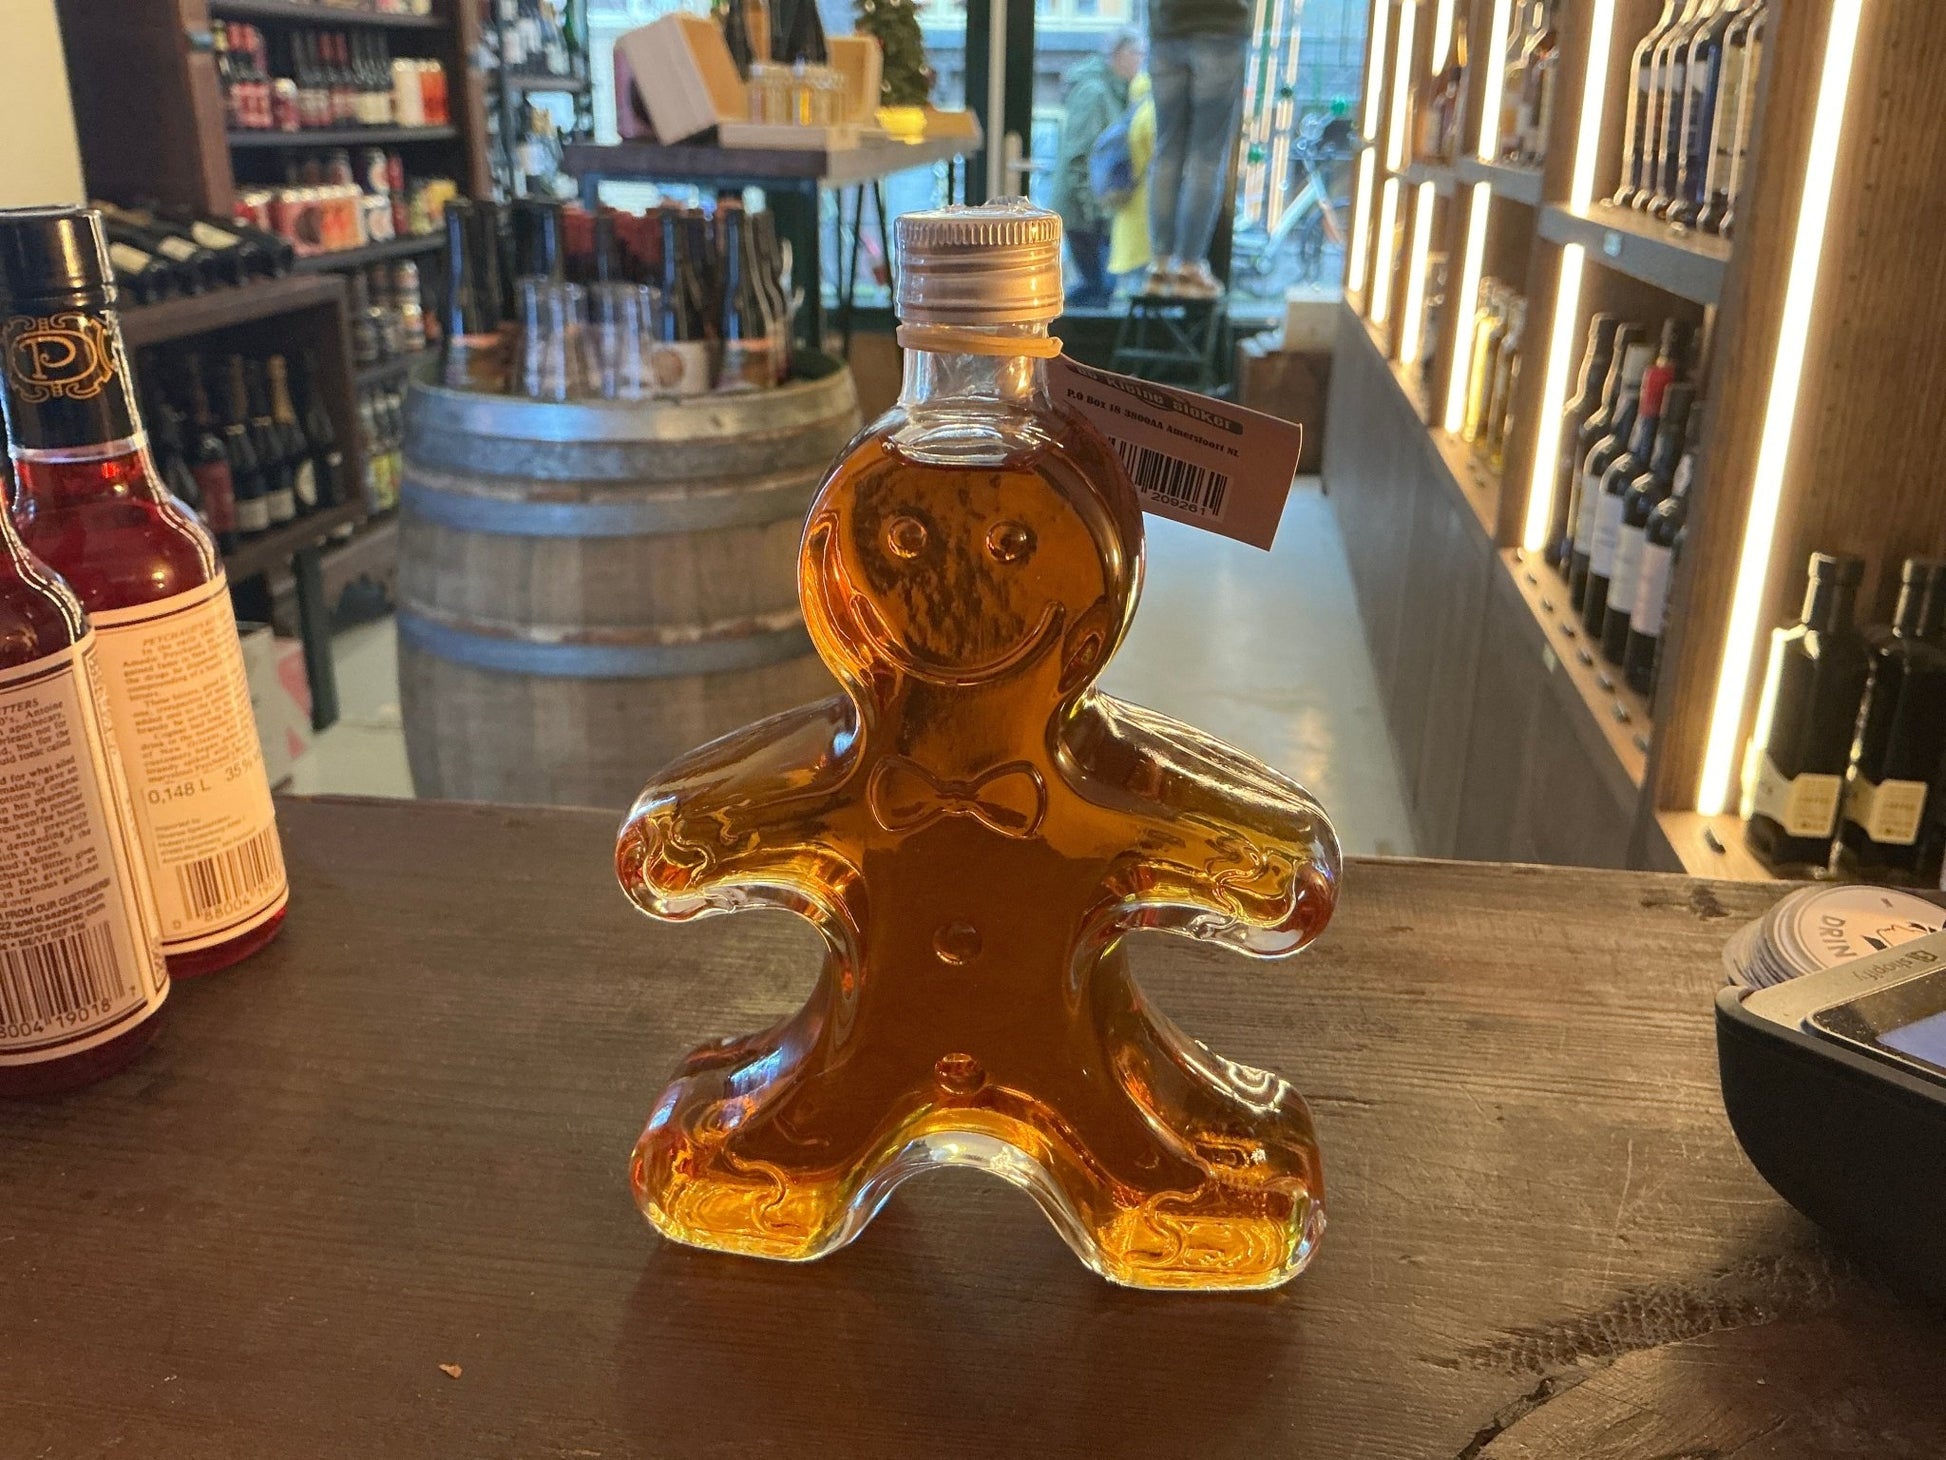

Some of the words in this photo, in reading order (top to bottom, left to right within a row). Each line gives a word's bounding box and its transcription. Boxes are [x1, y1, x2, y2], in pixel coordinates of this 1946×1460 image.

[1087, 394, 1105, 410] Box
[1109, 403, 1121, 415] 18
[1125, 408, 1163, 430] 3800AA
[1166, 425, 1224, 451] Amersfoort
[1227, 447, 1240, 458] NL
[1151, 492, 1206, 515] 209261
[11, 774, 25, 783] for
[29, 764, 52, 776] what
[35, 786, 45, 796] of
[148, 782, 195, 804] 0,148
[199, 777, 212, 792] L
[13, 802, 28, 811] his
[13, 810, 37, 820] been
[24, 814, 54, 828] coffee
[7, 831, 65, 850] demanding
[16, 829, 36, 840] and
[35, 842, 59, 853] dash
[42, 857, 72, 871] Bitters
[18, 877, 37, 886] has
[43, 866, 70, 880] given
[20, 881, 57, 895] famous
[4, 906, 33, 918] FROM
[35, 900, 57, 913] OUR
[56, 998, 111, 1028] 19018
